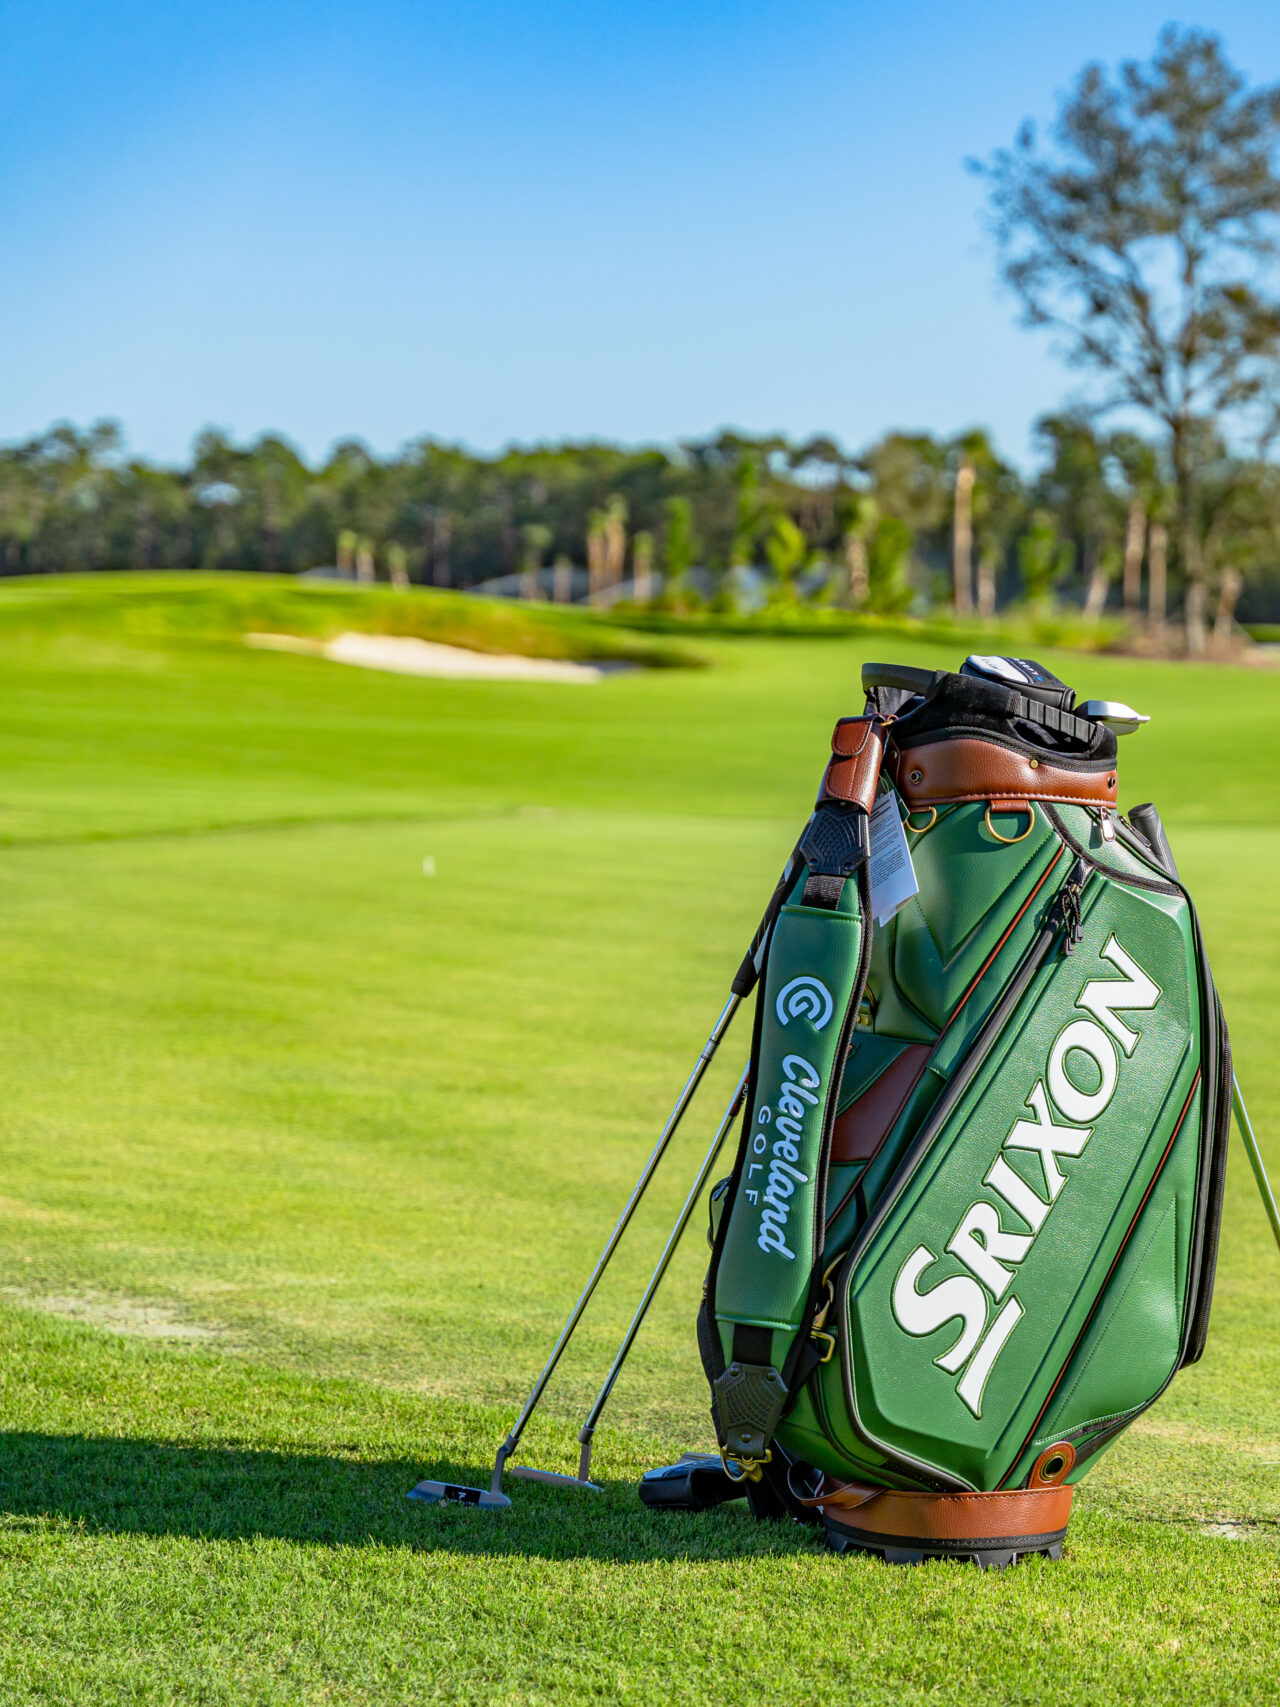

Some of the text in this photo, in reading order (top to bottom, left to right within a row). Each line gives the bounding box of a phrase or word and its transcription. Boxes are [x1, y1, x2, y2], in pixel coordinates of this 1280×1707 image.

[745, 1105, 772, 1206] GOLF
[757, 1054, 821, 1260] Cleveland
[893, 933, 1162, 1418] SRIXON
